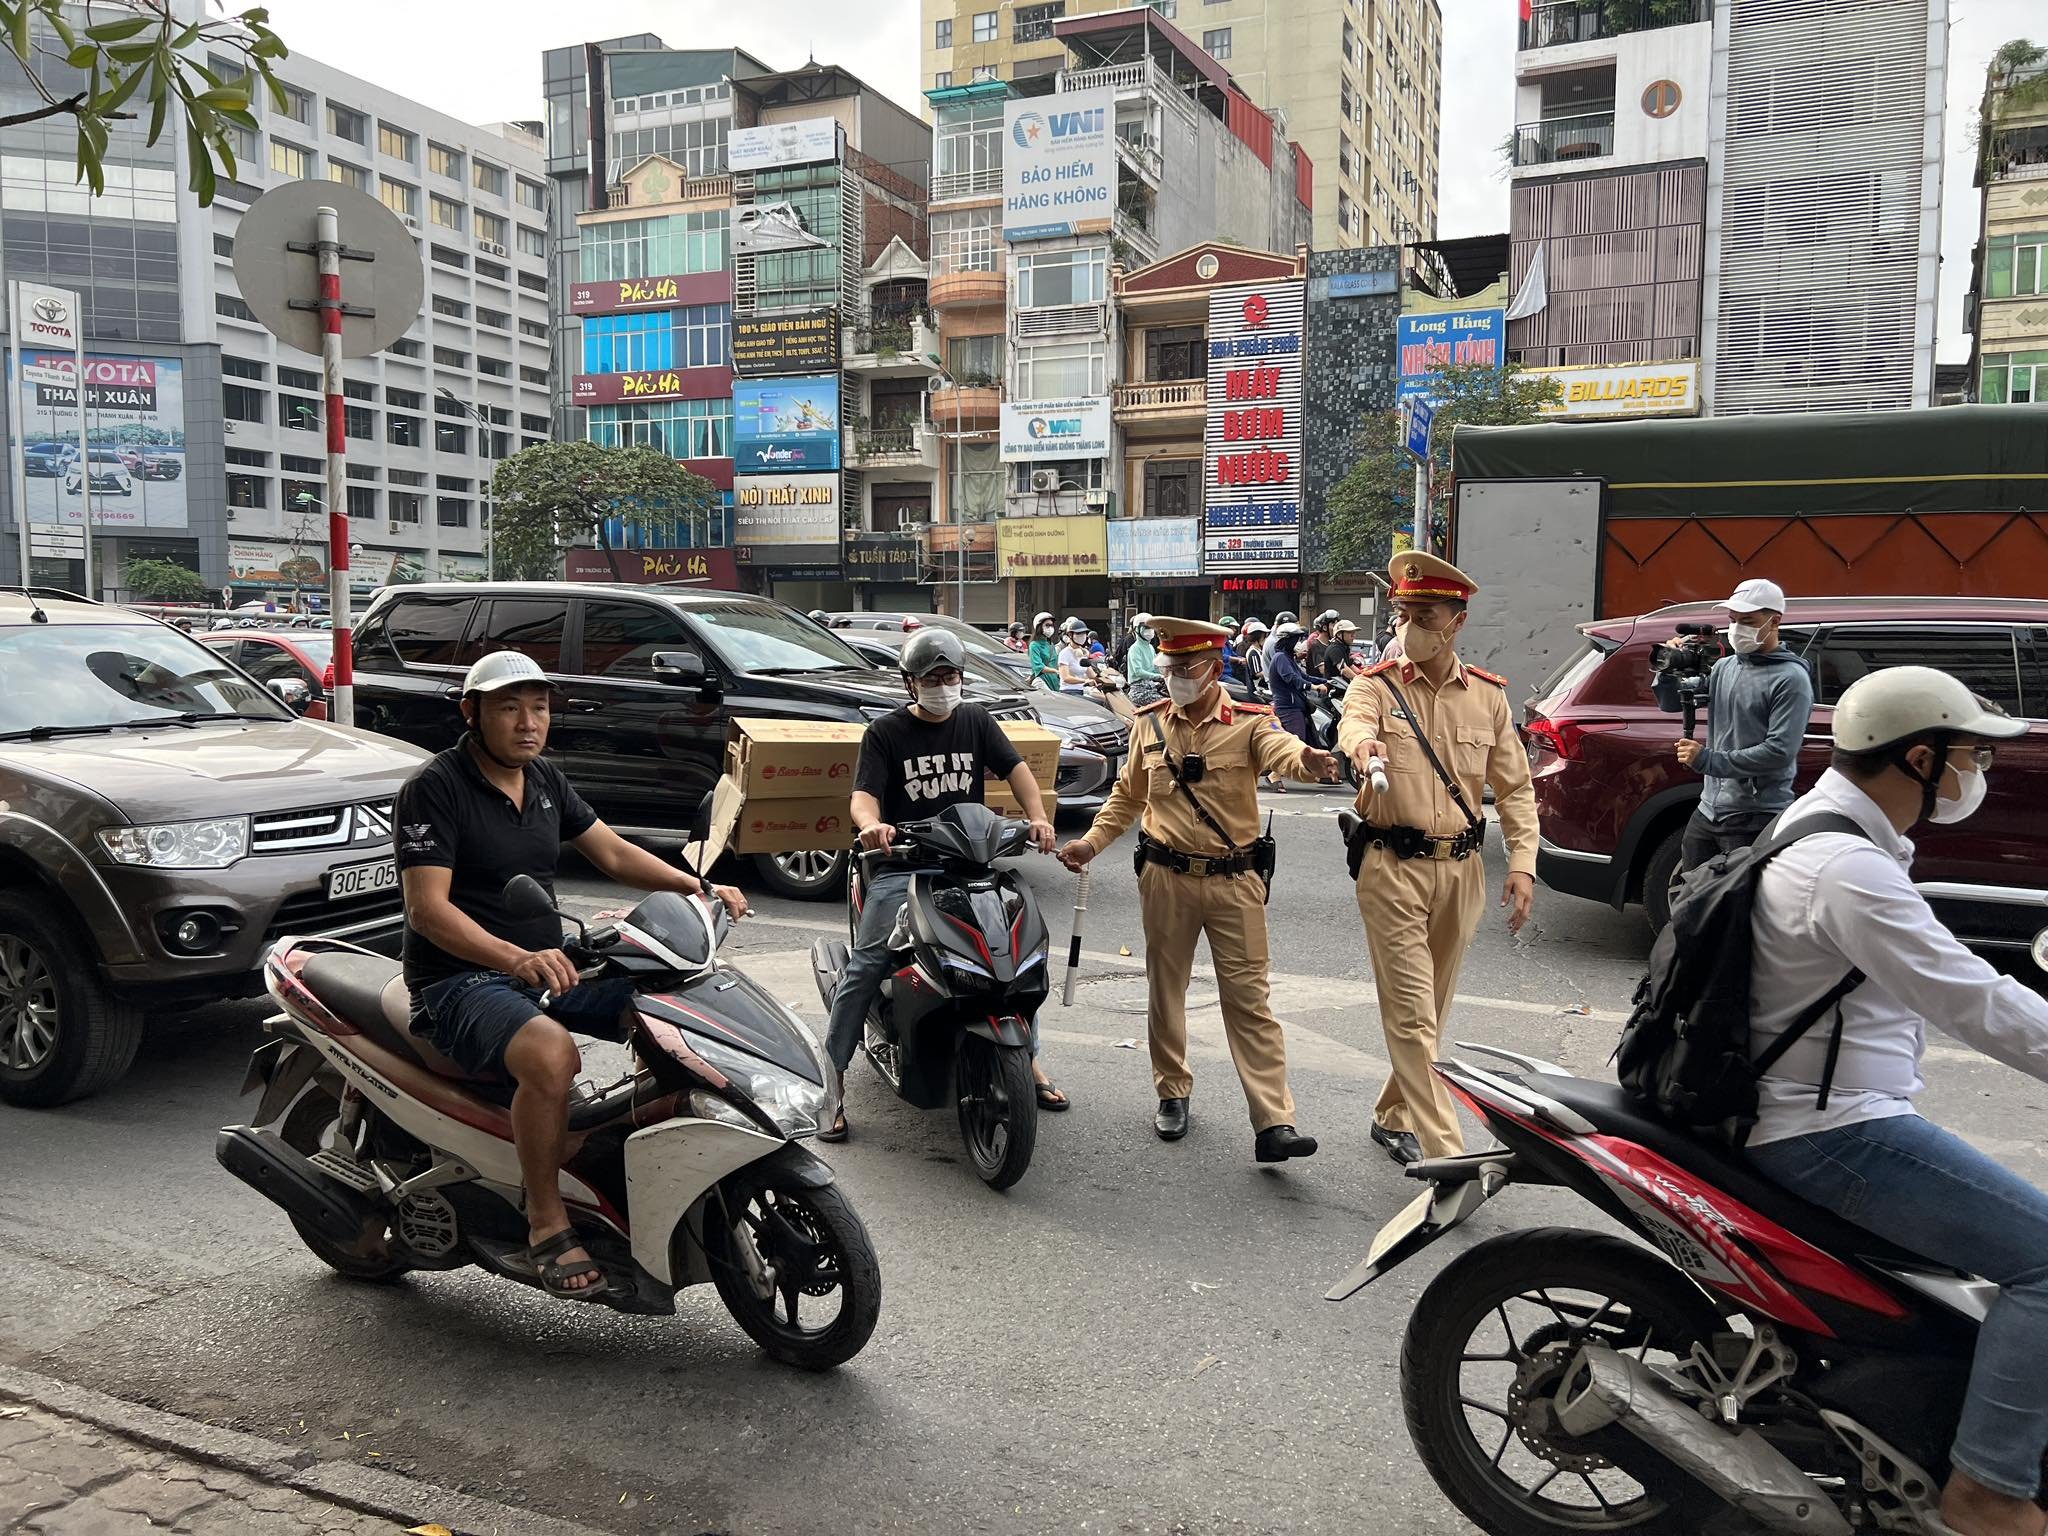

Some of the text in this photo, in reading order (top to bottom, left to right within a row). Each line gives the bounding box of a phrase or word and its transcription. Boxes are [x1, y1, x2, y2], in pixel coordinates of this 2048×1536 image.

[1048, 108, 1104, 137] VNI
[1021, 160, 1093, 184] BẢO HIỂM
[1008, 185, 1107, 211] HÀNG KHÔNG
[577, 279, 678, 303] 319 Phủ Hà
[31, 322, 71, 337] TOYOTA
[778, 320, 793, 331] VIÊN
[795, 317, 810, 330] BẢN
[1410, 314, 1492, 334] Long Hằng
[1402, 334, 1495, 376] NHÔM KÍNH
[579, 373, 680, 396] 319 Phủ Hà
[1226, 360, 1281, 400] MÁY
[1569, 376, 1688, 402] BILLIARDS
[105, 389, 151, 405] XUÂN
[1048, 419, 1081, 434] VNI
[1224, 407, 1283, 441] BƠM
[1218, 445, 1288, 485] NƯỚC
[740, 483, 832, 509] NỘI THẤT XINH
[738, 517, 753, 525] SIÊU
[860, 546, 906, 563] TUẤN TÁO
[1227, 538, 1242, 548] 329
[643, 555, 681, 576] Phủ
[687, 555, 708, 575] Hà
[1223, 577, 1244, 590] MÁY
[904, 753, 973, 780] LET IT
[904, 772, 973, 801] PUNK
[333, 864, 398, 895] 30E-05
[1655, 1174, 1735, 1232] WINNER
